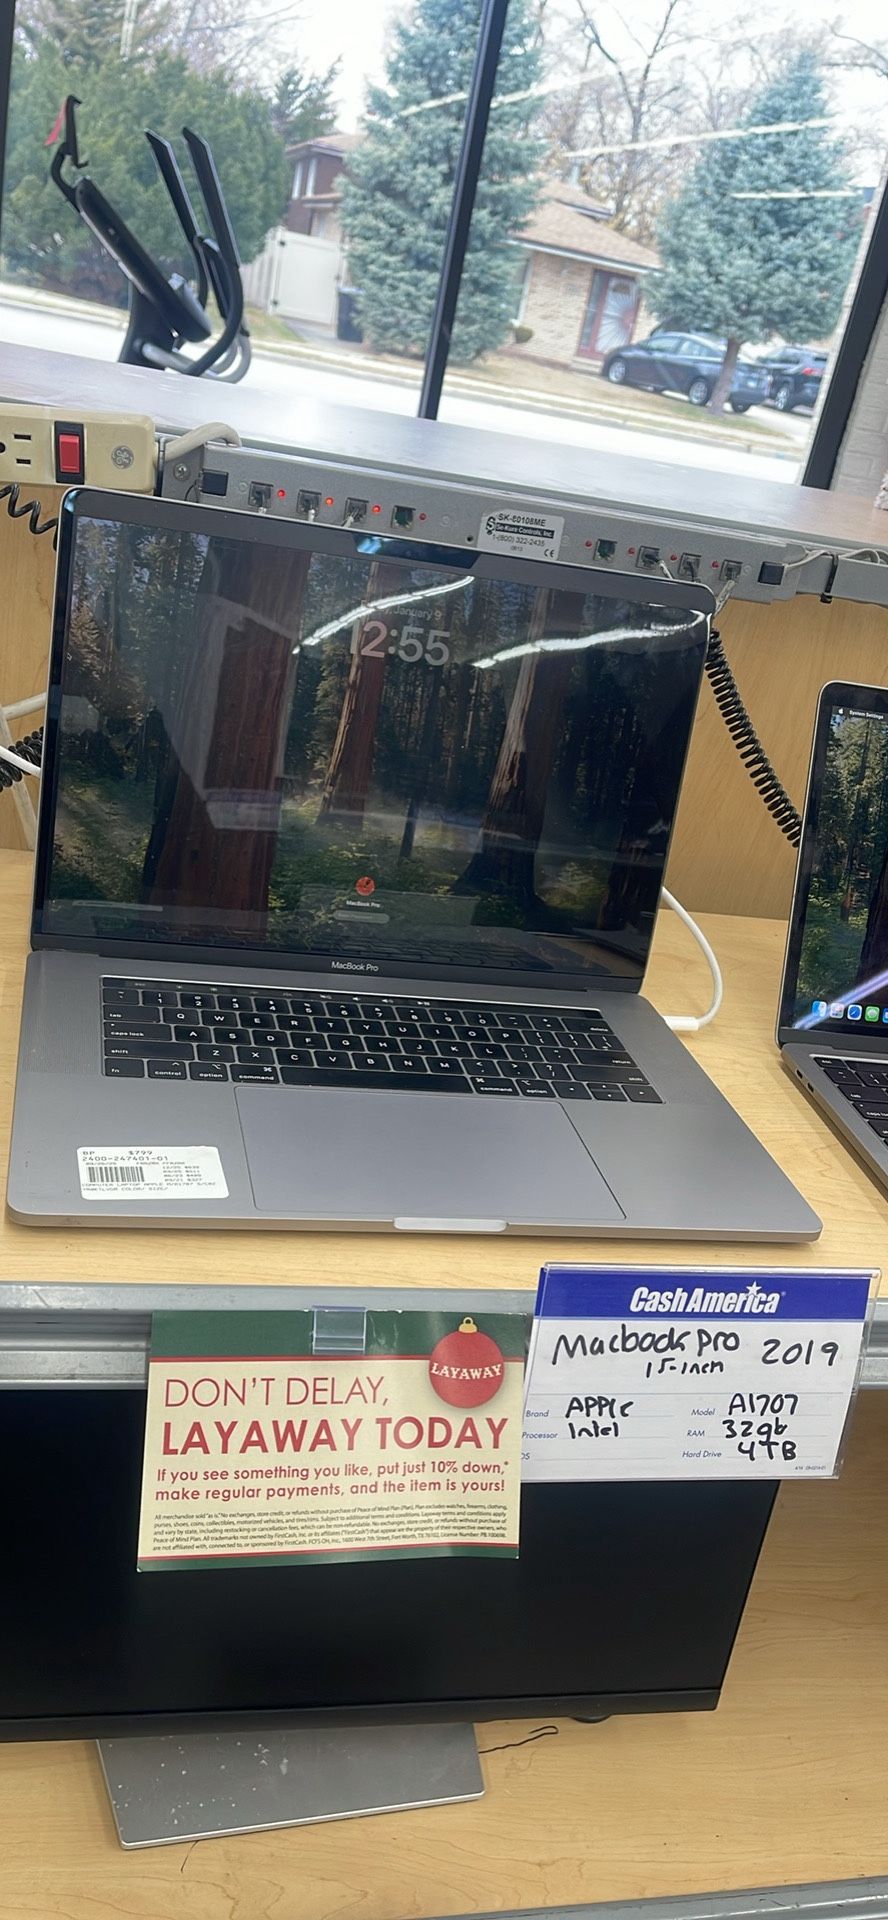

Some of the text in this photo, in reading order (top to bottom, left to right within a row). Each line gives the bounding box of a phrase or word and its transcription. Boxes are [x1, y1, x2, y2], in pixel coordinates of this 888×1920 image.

[434, 610, 442, 620] 9
[350, 618, 450, 666] 12:55
[331, 961, 379, 972] MacBook Pro
[761, 1338, 839, 1366] 2019
[430, 1362, 502, 1380] LAYAWAY
[164, 1376, 389, 1408] DON'T DELAY,
[690, 1408, 716, 1416] Model
[728, 1393, 799, 1416] A1707
[162, 1416, 508, 1455] LAYAWAY TODAY
[522, 1432, 558, 1440] Processor
[737, 1440, 796, 1462] 4TB
[157, 1468, 167, 1482] If
[170, 1470, 198, 1484] you
[203, 1470, 229, 1480] see
[234, 1466, 309, 1481] something
[314, 1467, 340, 1480] you
[344, 1464, 372, 1477] like,
[378, 1462, 400, 1478] put
[402, 1461, 426, 1476] just
[430, 1460, 458, 1473] 10%
[156, 1478, 505, 1502] make regular payments, and the item is yours!
